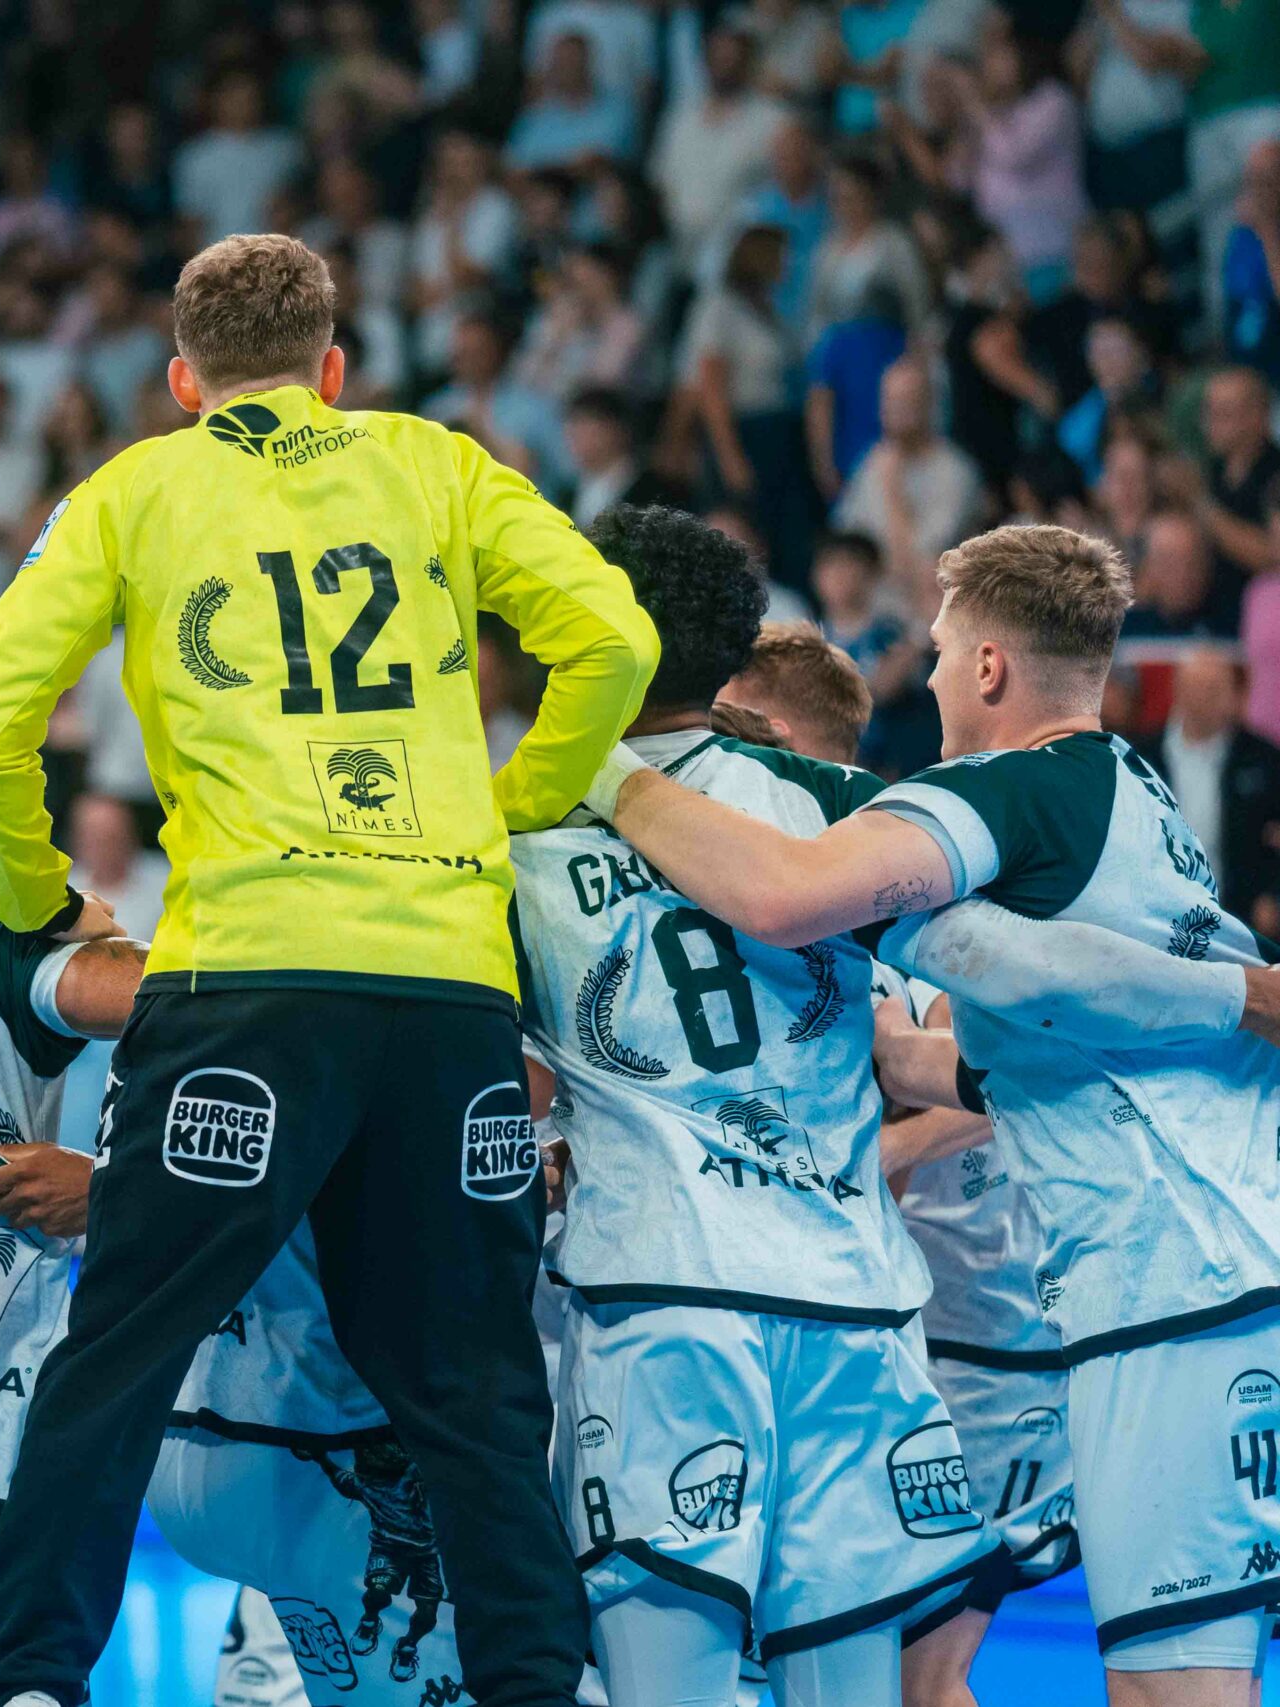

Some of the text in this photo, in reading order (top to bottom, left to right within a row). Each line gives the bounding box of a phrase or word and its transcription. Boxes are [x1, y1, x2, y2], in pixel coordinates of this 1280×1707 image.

[257, 541, 415, 715] 12
[336, 810, 413, 831] NÎMES
[651, 905, 761, 1075] 8
[173, 1101, 269, 1134] BURGER
[168, 1123, 264, 1165] KING
[466, 1141, 537, 1177] KING
[1238, 1384, 1272, 1395] USAM
[894, 1459, 966, 1491] BURG
[1230, 1429, 1278, 1500] 41
[899, 1481, 970, 1520] KIN
[994, 1459, 1042, 1518] 11
[582, 1476, 616, 1546] 8
[1152, 1574, 1212, 1597] 2026/2027
